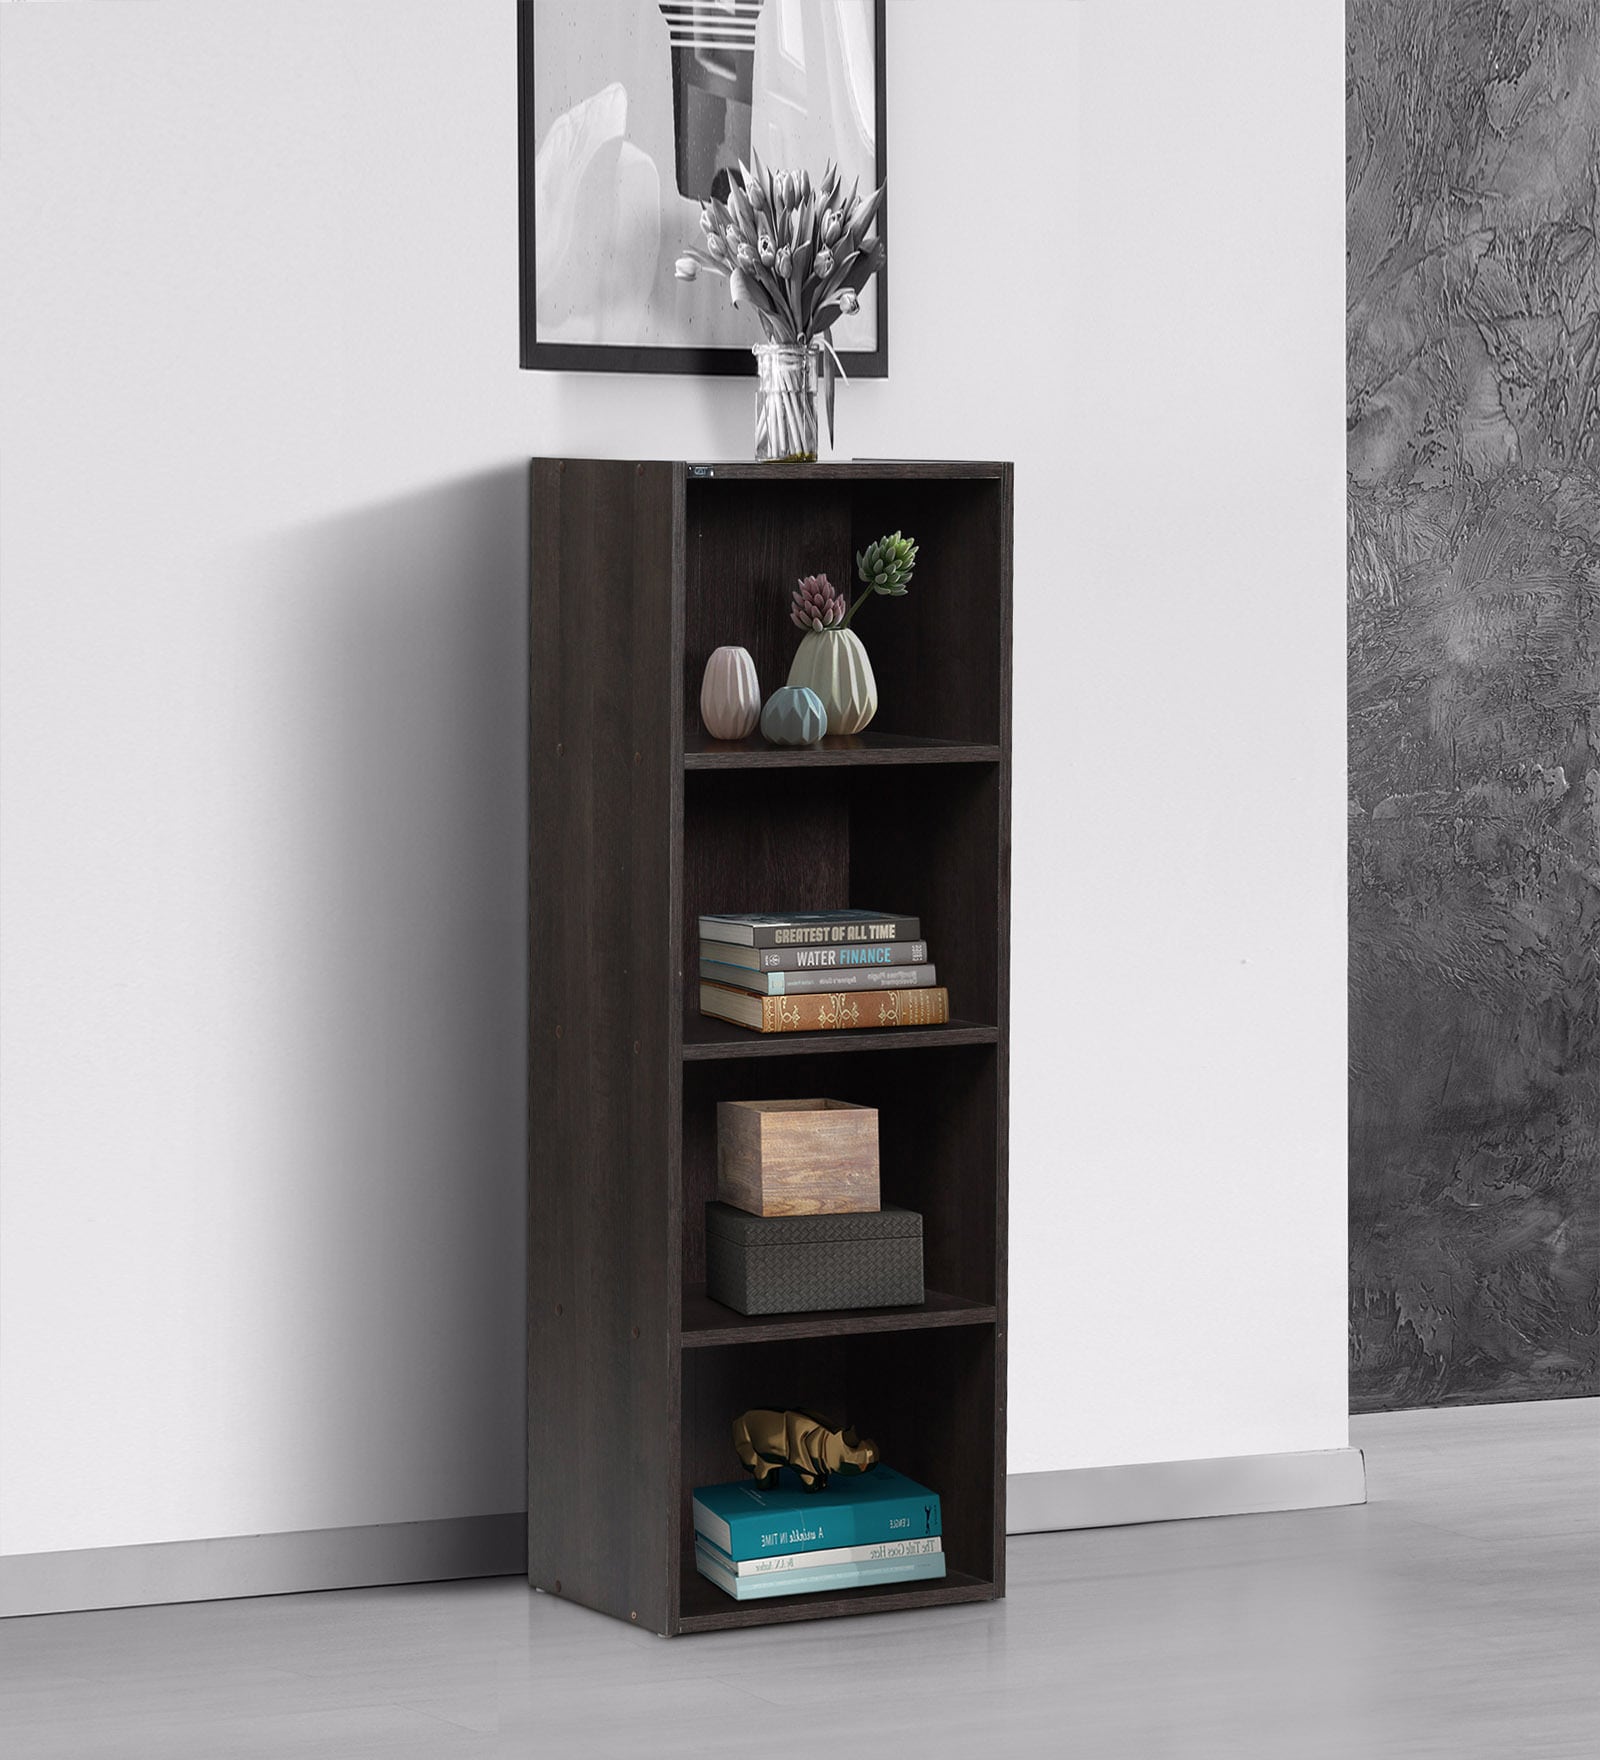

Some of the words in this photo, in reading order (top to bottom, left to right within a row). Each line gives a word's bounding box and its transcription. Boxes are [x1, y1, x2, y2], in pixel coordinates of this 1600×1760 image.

[775, 927, 831, 944] GREATEST
[832, 927, 846, 942] OF
[848, 925, 867, 940] ALL
[869, 924, 896, 940] TIME
[797, 951, 836, 967] WATER
[840, 948, 892, 964] FINANCE
